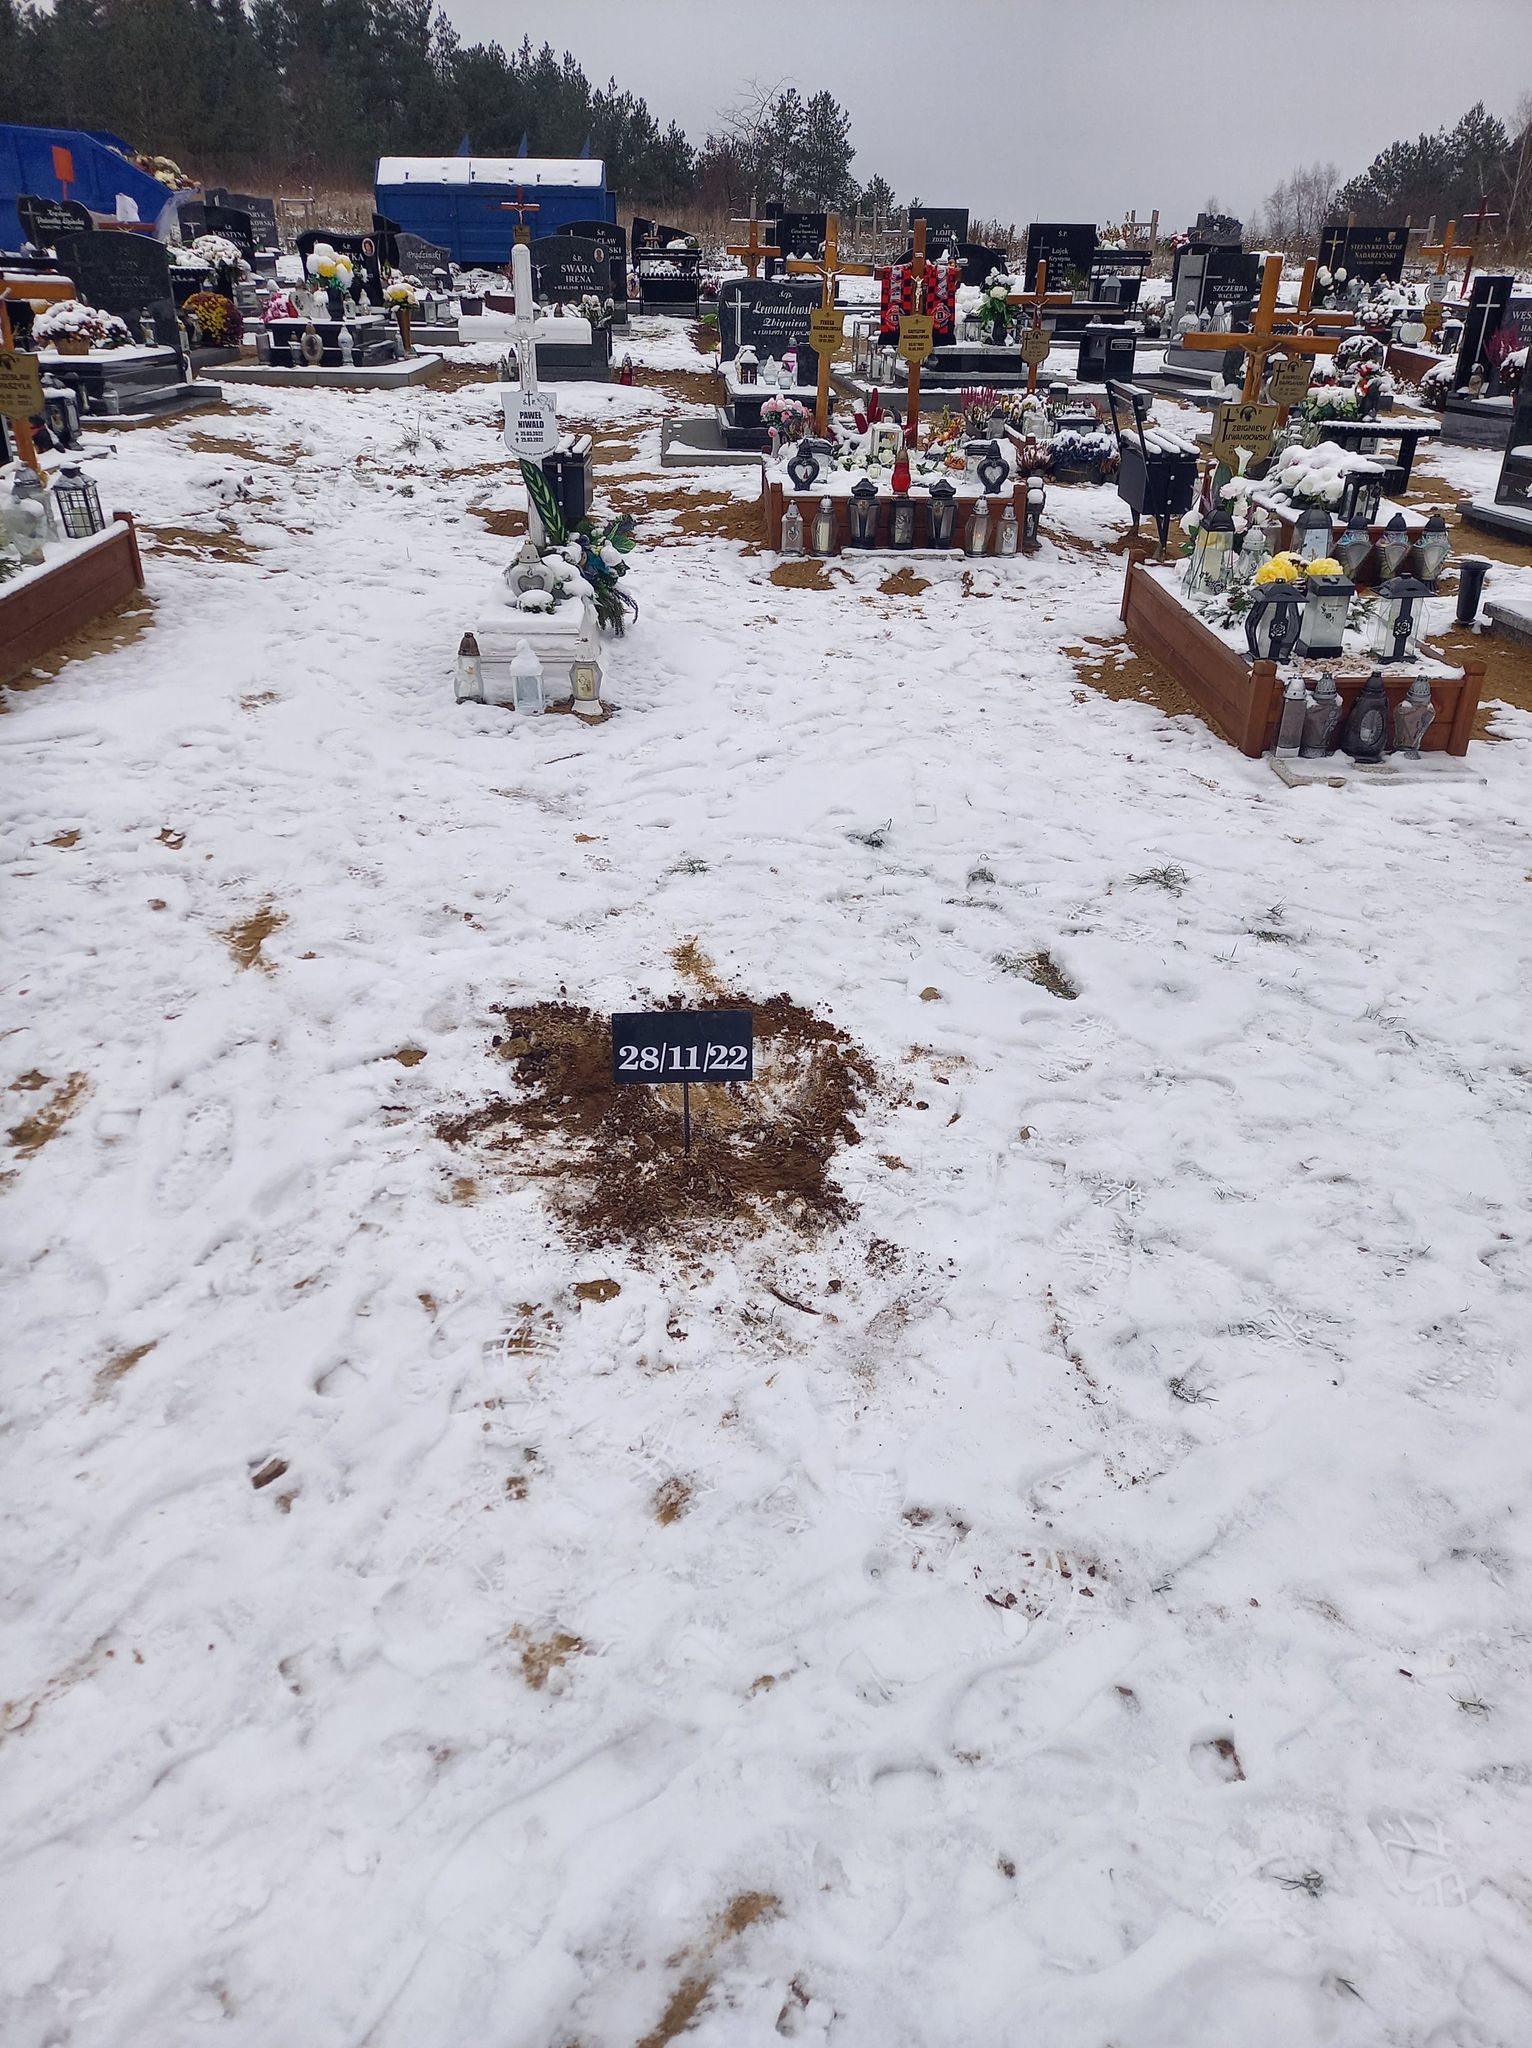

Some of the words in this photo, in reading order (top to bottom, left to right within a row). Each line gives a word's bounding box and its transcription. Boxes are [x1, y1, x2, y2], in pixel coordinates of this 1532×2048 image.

[572, 254, 583, 262] Ś.P.
[560, 264, 595, 273] SWARA
[565, 275, 592, 283] IRENA
[761, 317, 807, 329] Zbigniew
[519, 411, 543, 420] PAWEŁ
[517, 420, 545, 429] NIWALD
[1231, 424, 1268, 432] ZBIGNIEW
[618, 1042, 748, 1073] 28/11/22
